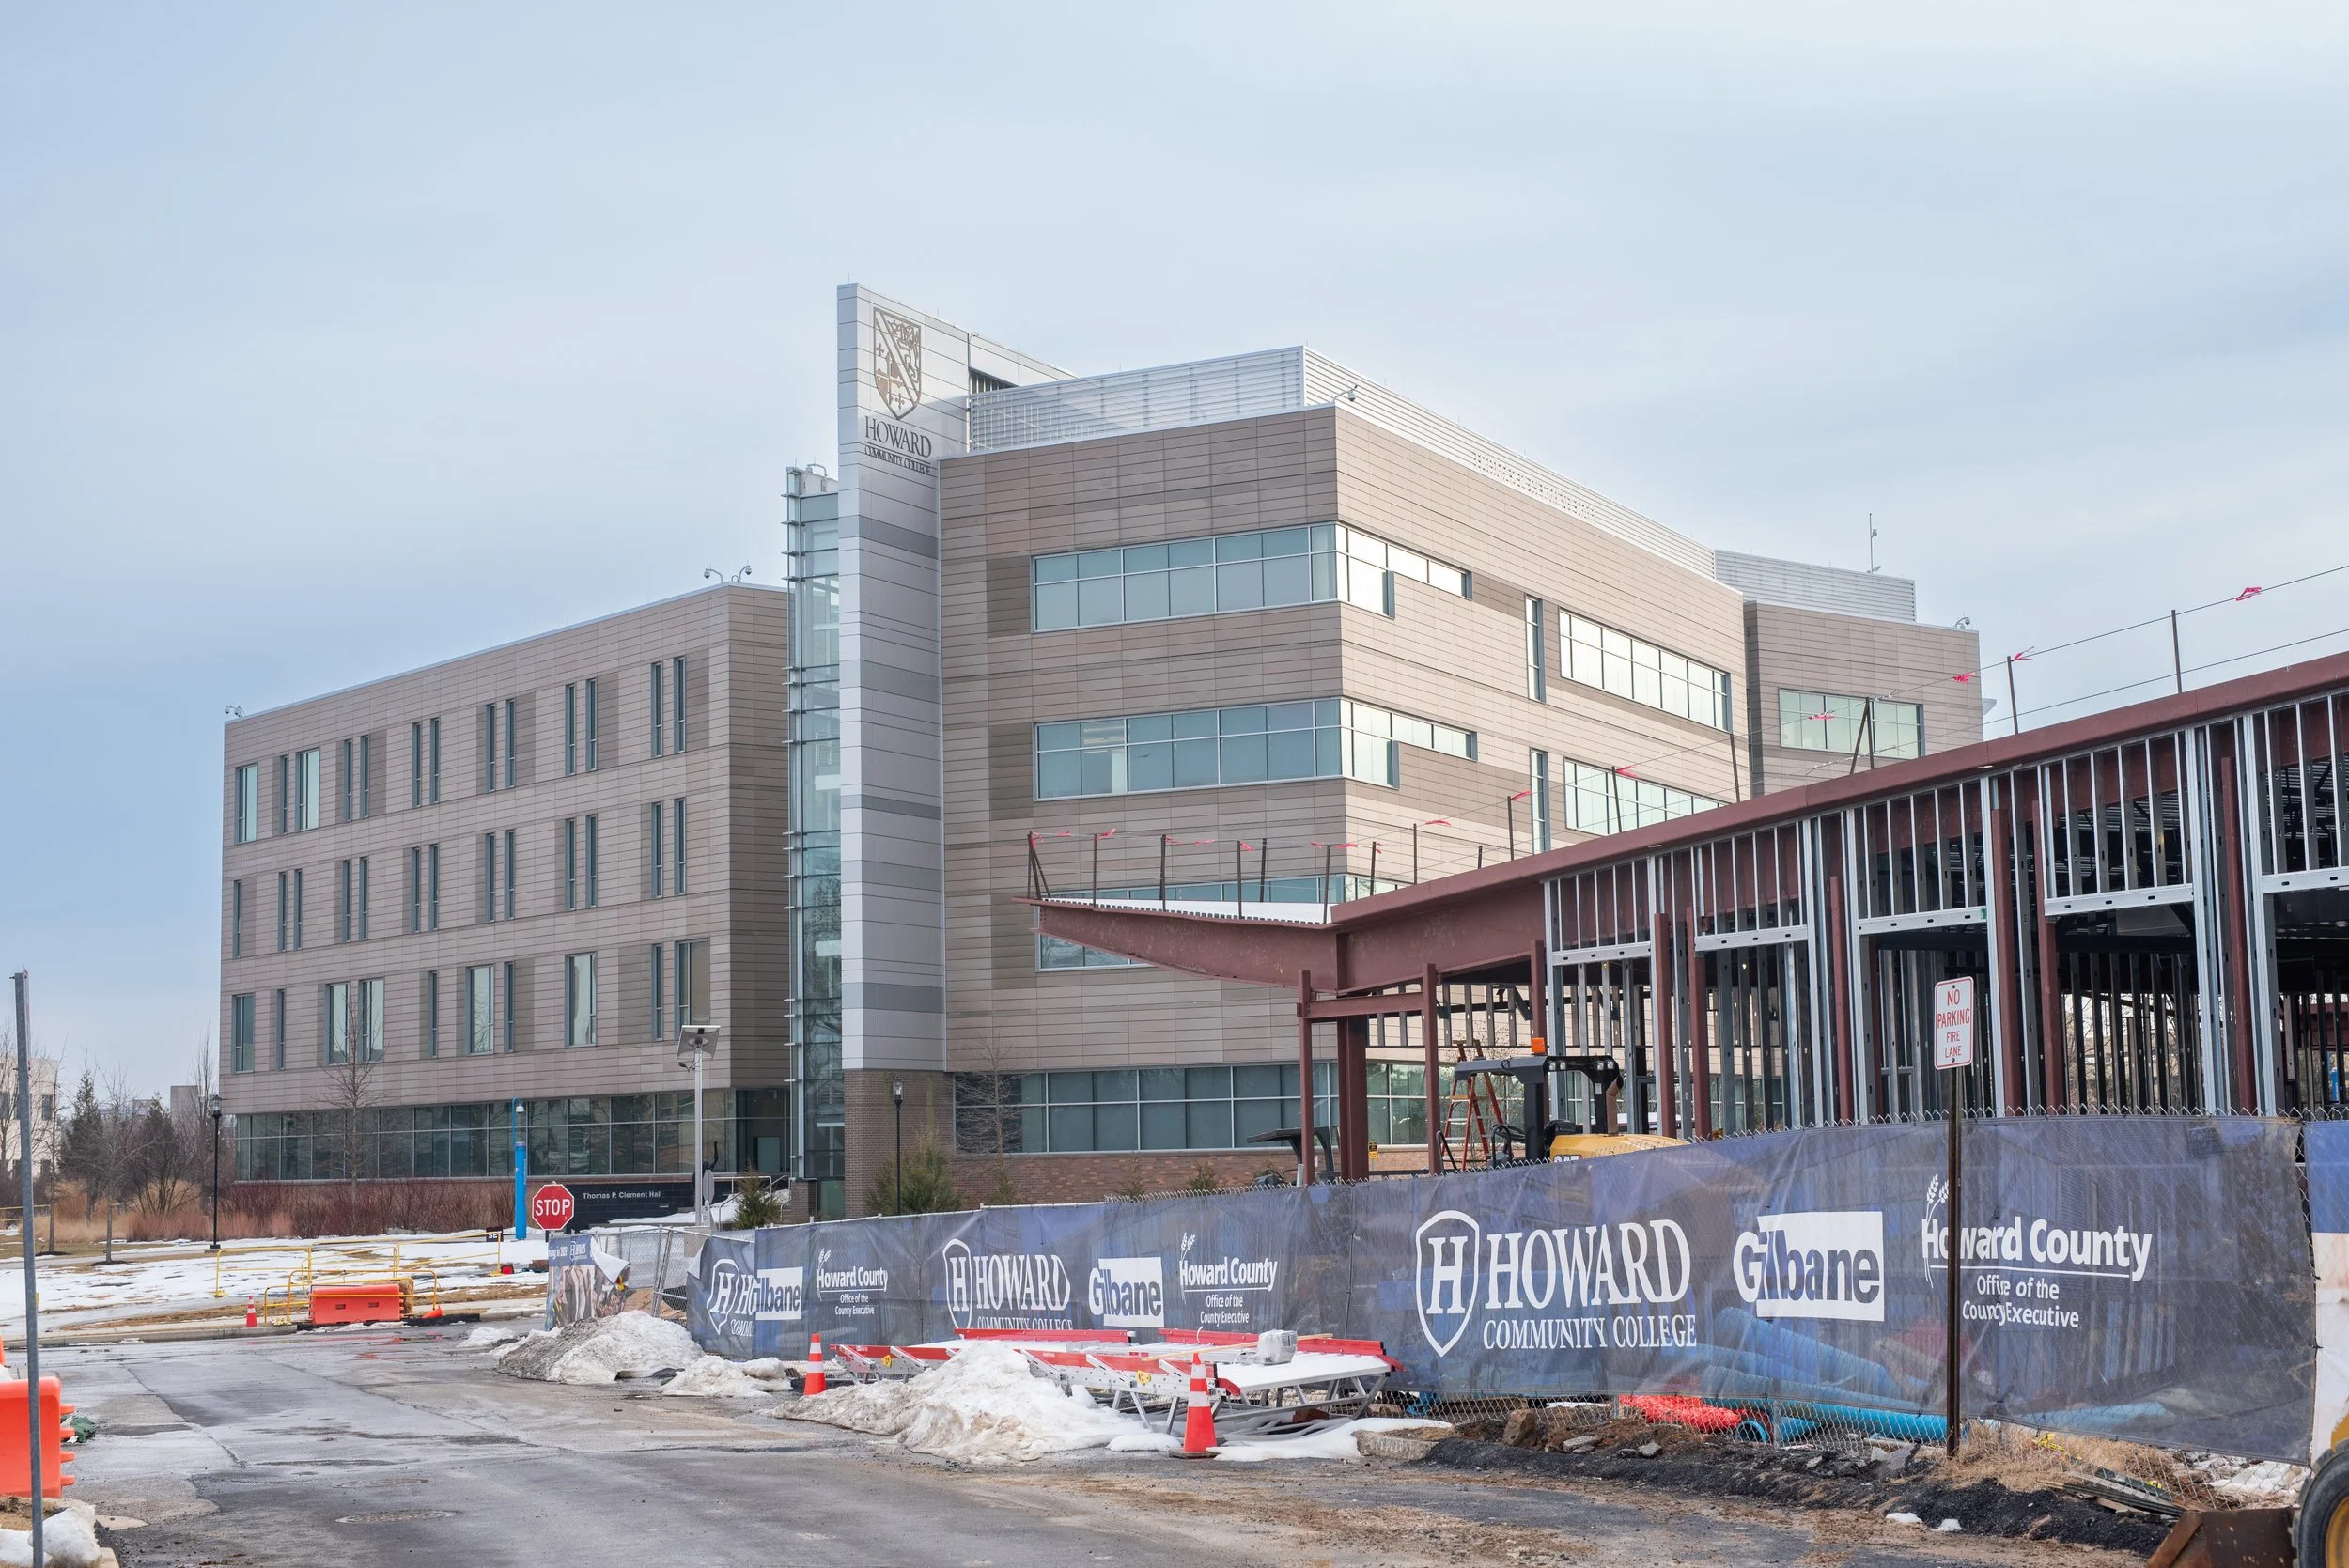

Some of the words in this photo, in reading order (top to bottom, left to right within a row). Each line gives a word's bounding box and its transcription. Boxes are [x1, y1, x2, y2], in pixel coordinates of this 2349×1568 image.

[865, 415, 932, 458] HOWARD
[1947, 988, 1961, 1006] NO
[1937, 1008, 1970, 1029] PARKING
[1946, 1031, 1961, 1043] FIRE
[1945, 1046, 1962, 1058] LANE
[535, 1198, 571, 1217] STOP
[2030, 1219, 2153, 1282] County
[1179, 1256, 1228, 1286] Howard
[1230, 1257, 1278, 1291] County
[1485, 1219, 1690, 1310] HOWARD
[1733, 1227, 1880, 1305] Gilbane
[816, 1266, 857, 1288] Howard
[858, 1266, 888, 1292] County
[973, 1254, 1071, 1311] HOWARD
[2015, 1277, 2034, 1297] of
[2036, 1278, 2060, 1299] the
[840, 1294, 854, 1304] Office
[855, 1294, 861, 1303] of
[861, 1293, 869, 1303] the
[1088, 1266, 1162, 1316] Gilbane
[1206, 1295, 1224, 1308] Office
[1225, 1294, 1233, 1307] of
[1233, 1294, 1244, 1307] the
[834, 1306, 852, 1317] County
[852, 1305, 875, 1315] Executive
[1200, 1311, 1221, 1327] County
[1221, 1310, 1250, 1324] Executive
[2006, 1302, 2079, 1327] Executive
[977, 1316, 1030, 1330] COMMUNITY
[1032, 1317, 1073, 1330] COLLEGE
[1483, 1317, 1608, 1350] COMMUNITY
[1612, 1314, 1697, 1348] COLLEGE
